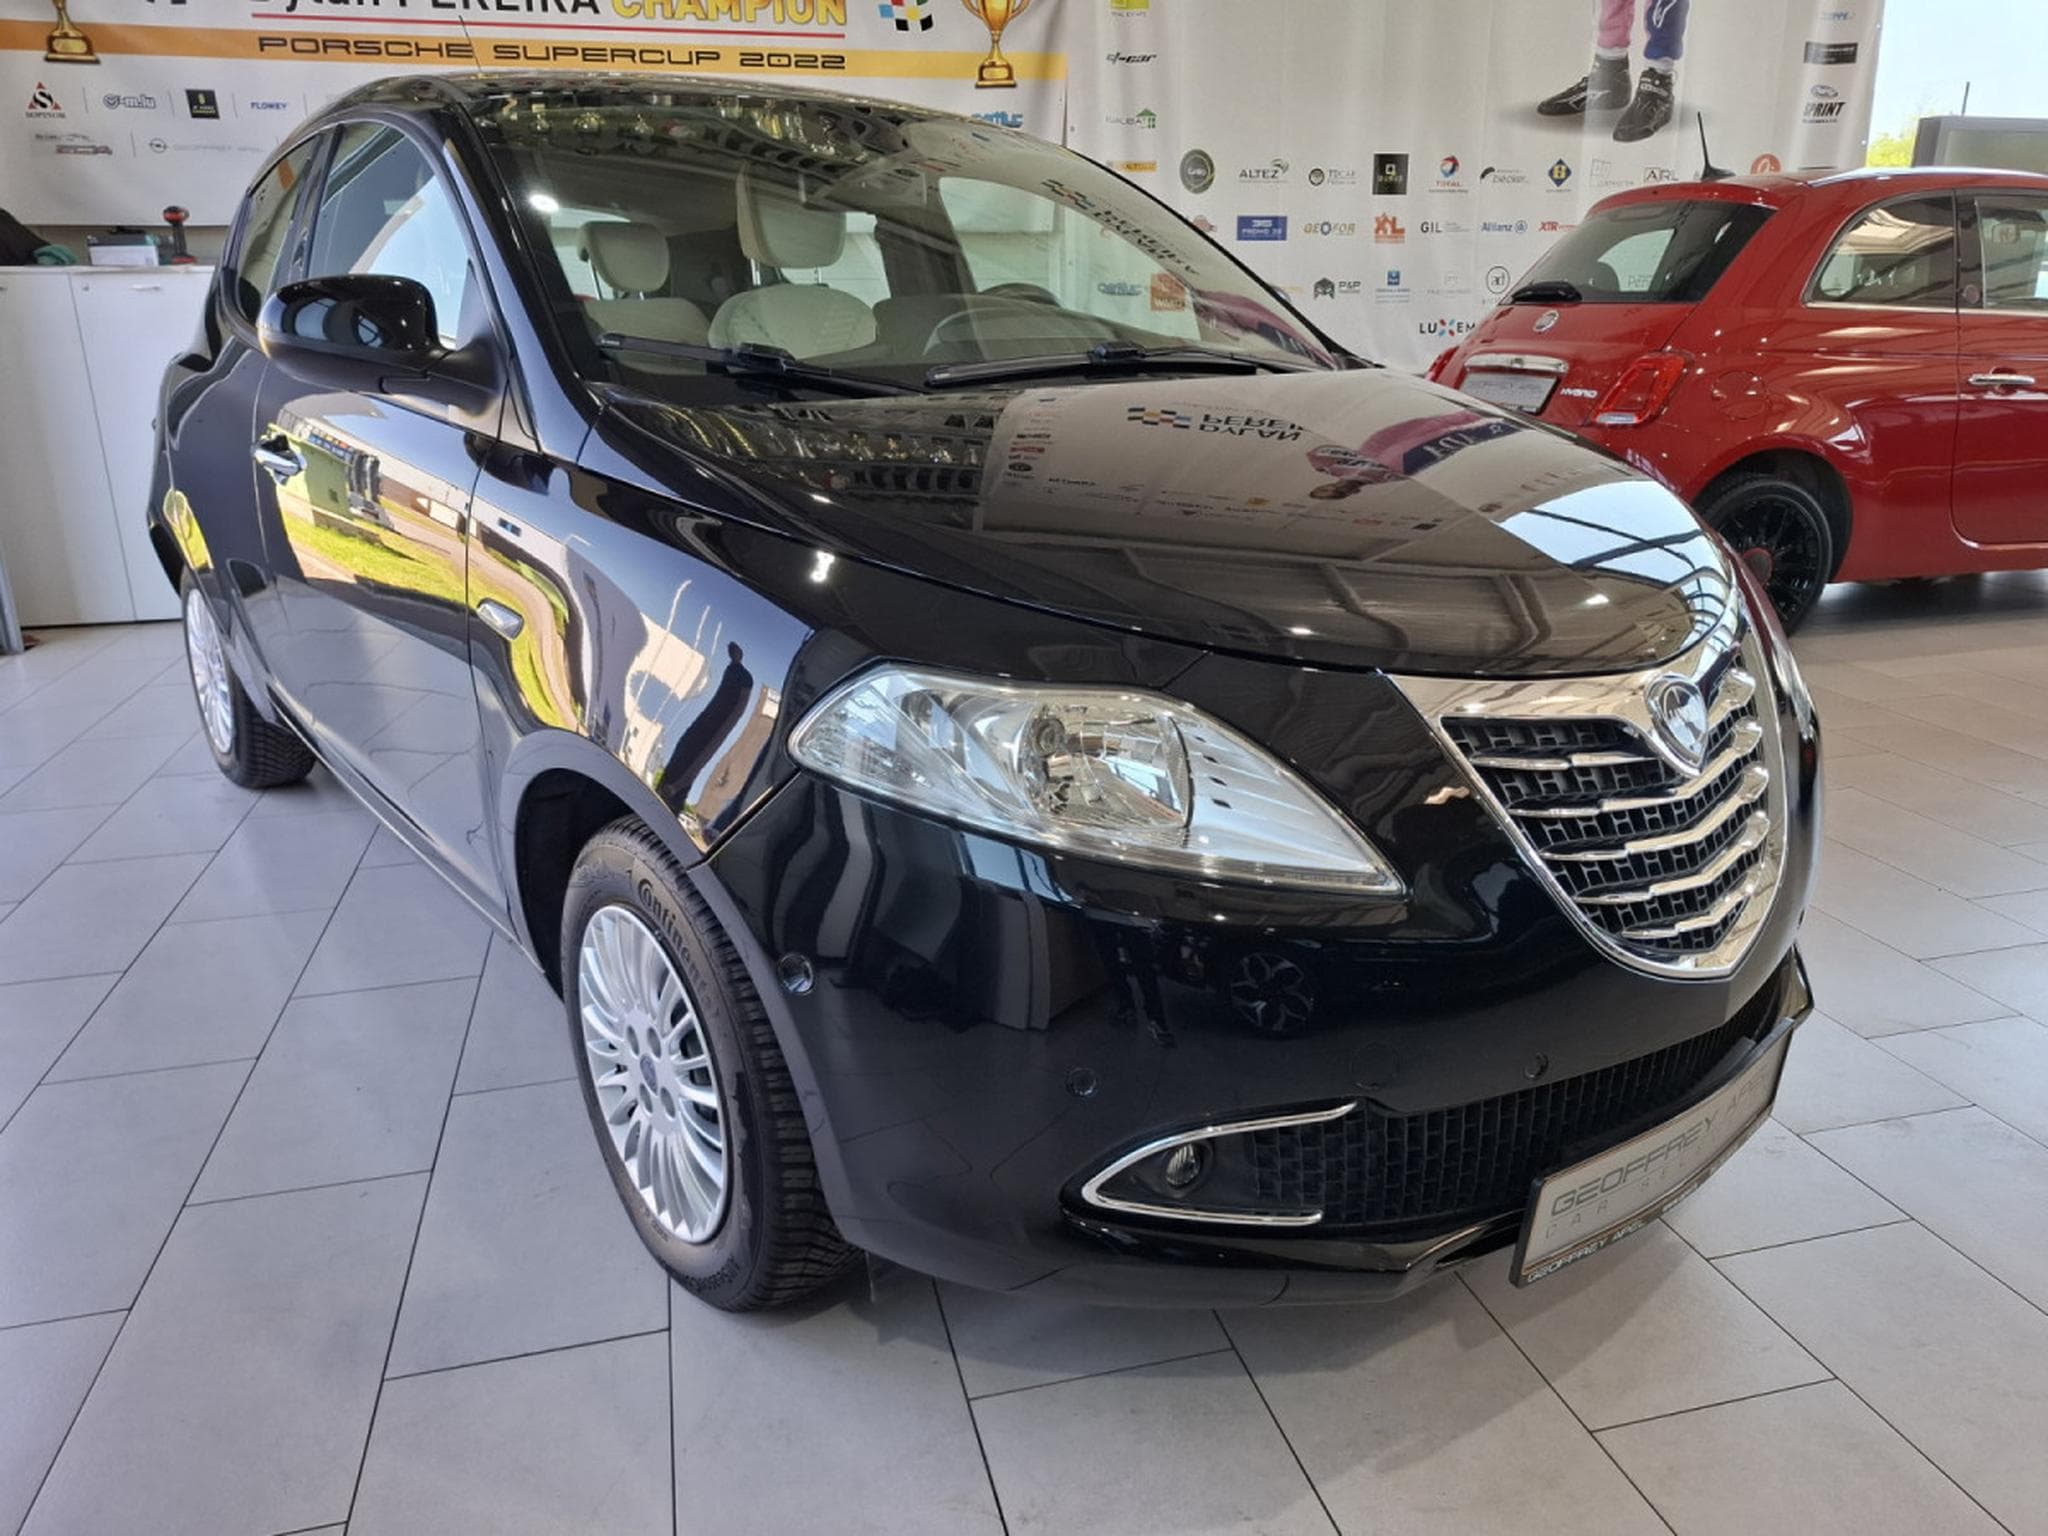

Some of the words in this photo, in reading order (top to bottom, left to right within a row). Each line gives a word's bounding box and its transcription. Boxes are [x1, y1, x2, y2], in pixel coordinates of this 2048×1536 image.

[611, 0, 847, 25] CHAMPION
[258, 36, 474, 59] PORSCHE
[493, 44, 721, 66] SUPERCUP
[739, 52, 846, 69] 2022
[250, 101, 288, 110] FLOWEY
[1239, 168, 1280, 179] ALTEZ
[1420, 221, 1442, 234] GIL
[1481, 222, 1513, 233] Allianz
[1551, 1116, 1714, 1217] GEOFFREY
